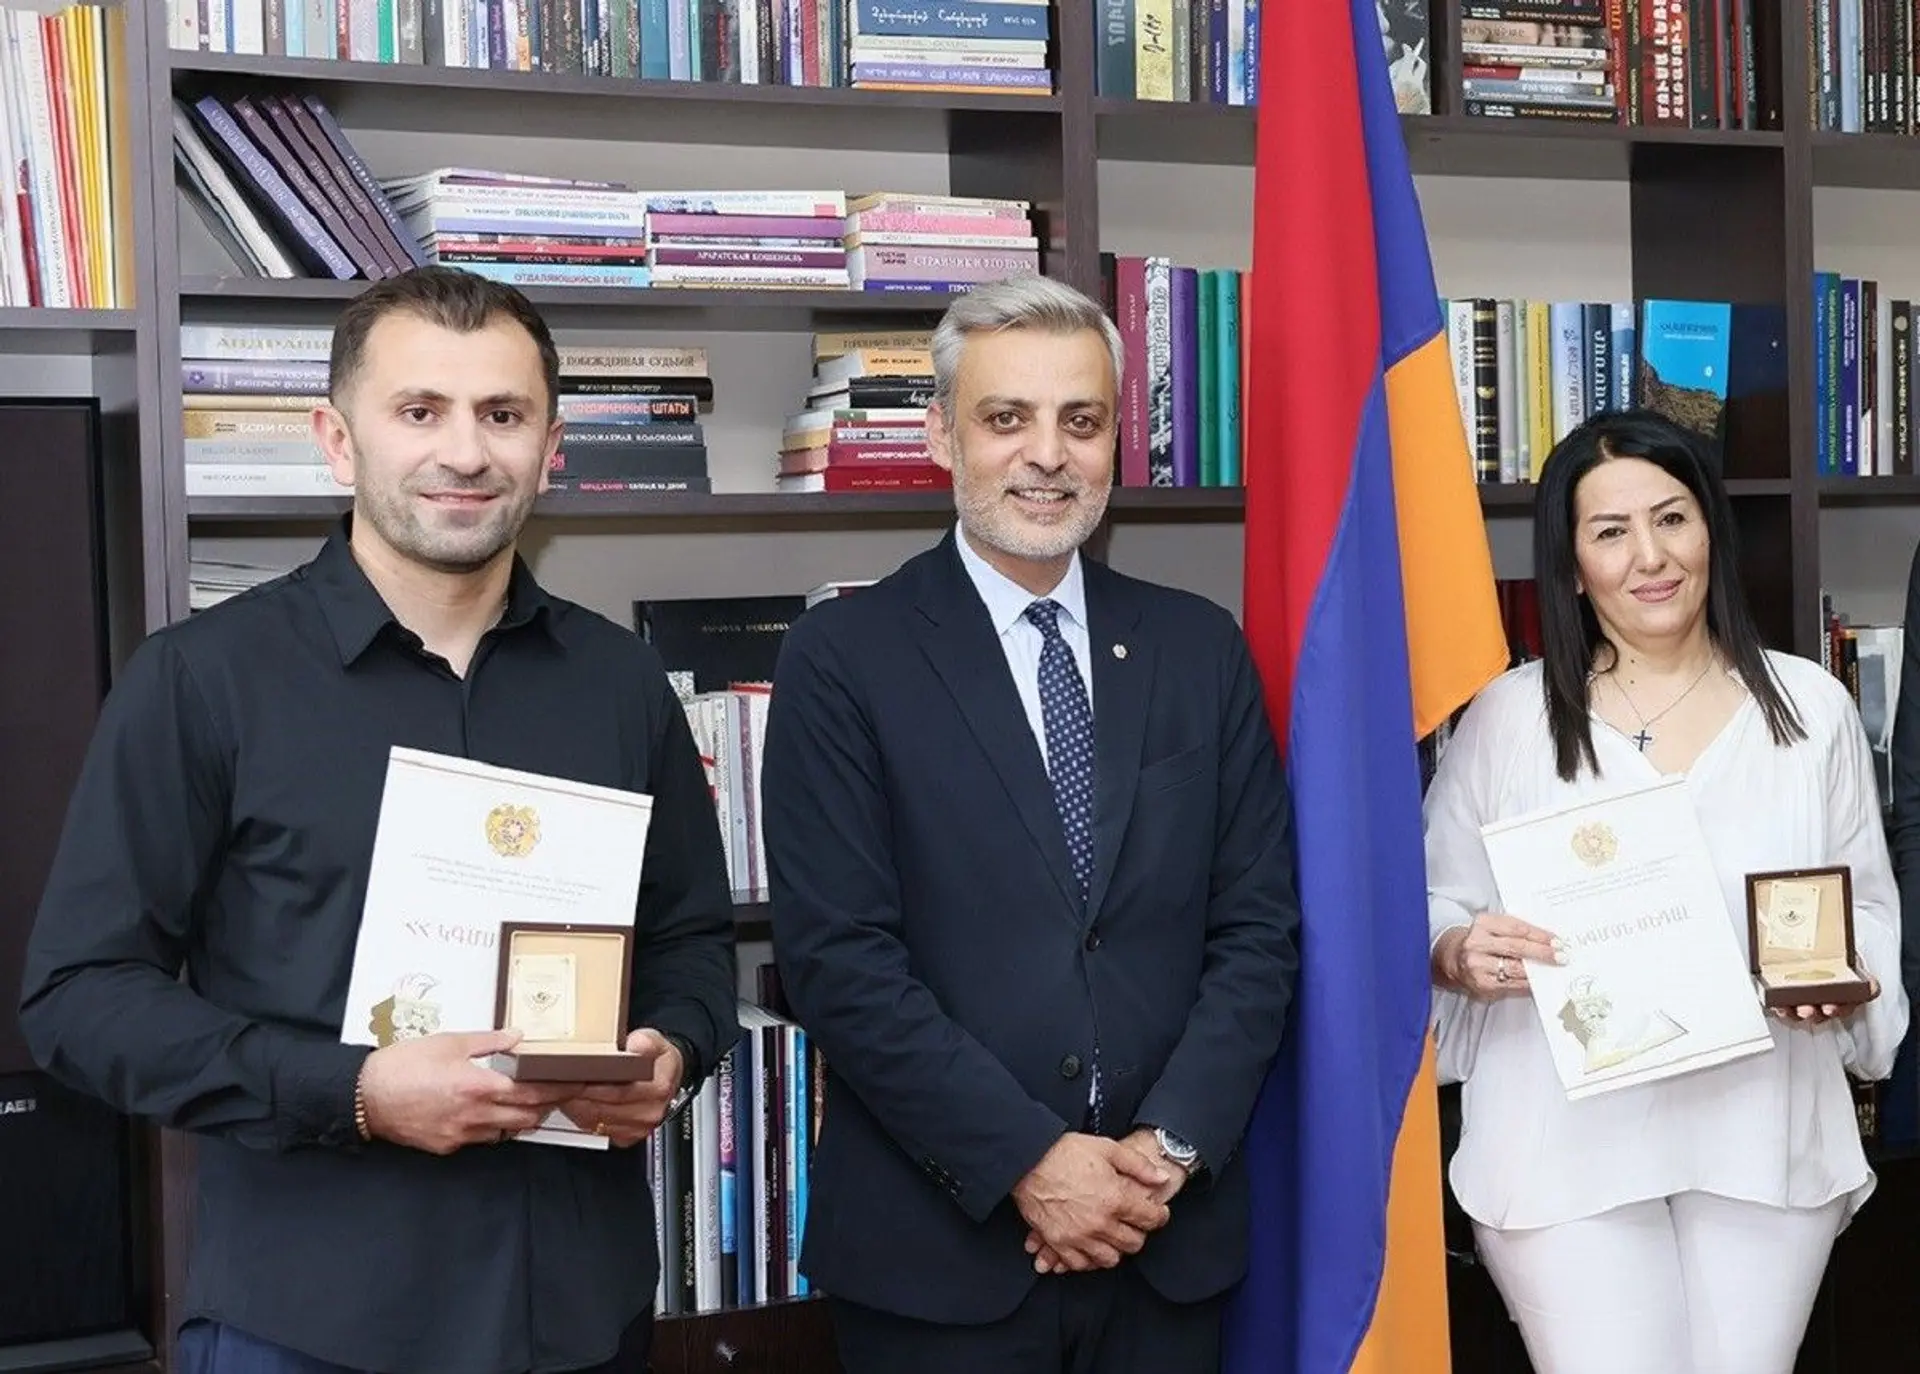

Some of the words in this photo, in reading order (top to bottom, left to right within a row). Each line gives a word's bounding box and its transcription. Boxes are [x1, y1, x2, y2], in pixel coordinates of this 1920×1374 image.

[697, 251, 750, 261] АРАРАТСКАЯ
[602, 276, 633, 285] БЕРЕГ
[651, 402, 690, 415] ШТАТЫ
